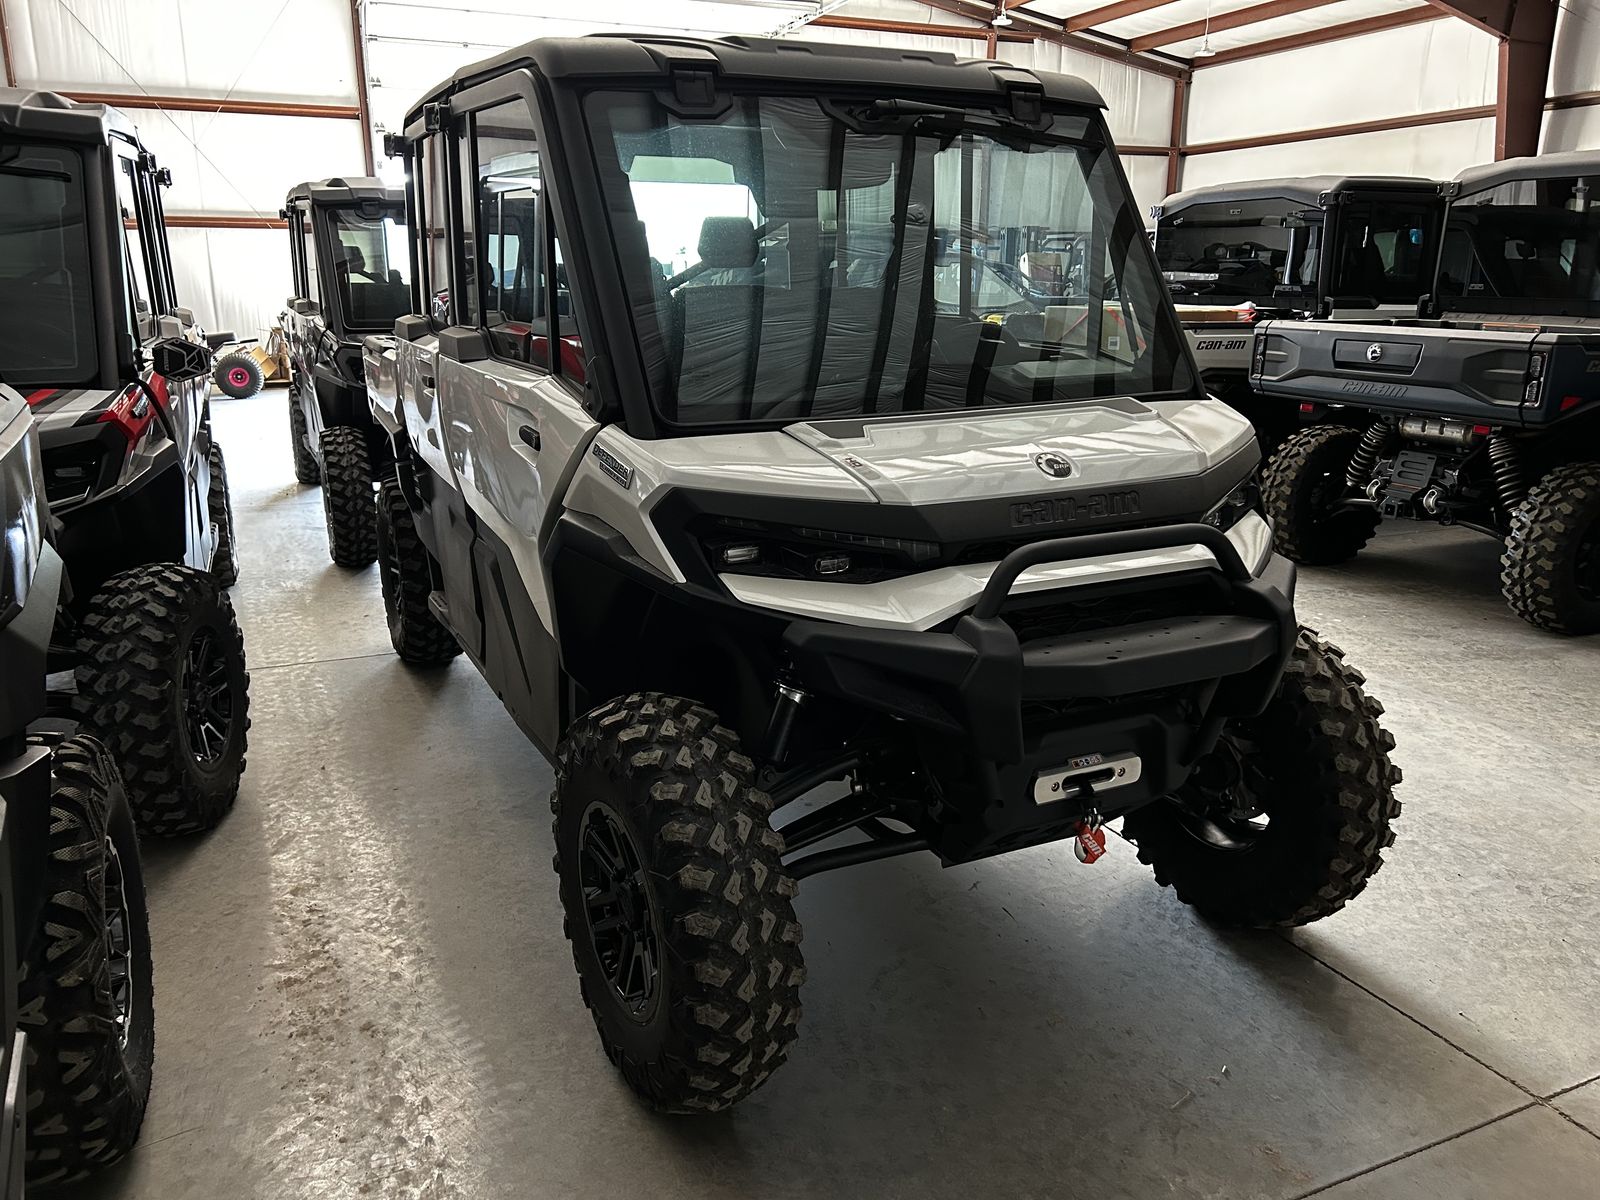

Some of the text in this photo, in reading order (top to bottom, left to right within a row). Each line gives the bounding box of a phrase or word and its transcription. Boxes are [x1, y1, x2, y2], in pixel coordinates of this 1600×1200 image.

[1196, 340, 1247, 351] can-am
[1342, 380, 1409, 398] can-am
[593, 444, 629, 477] DEFENDER
[1009, 489, 1141, 528] can-am
